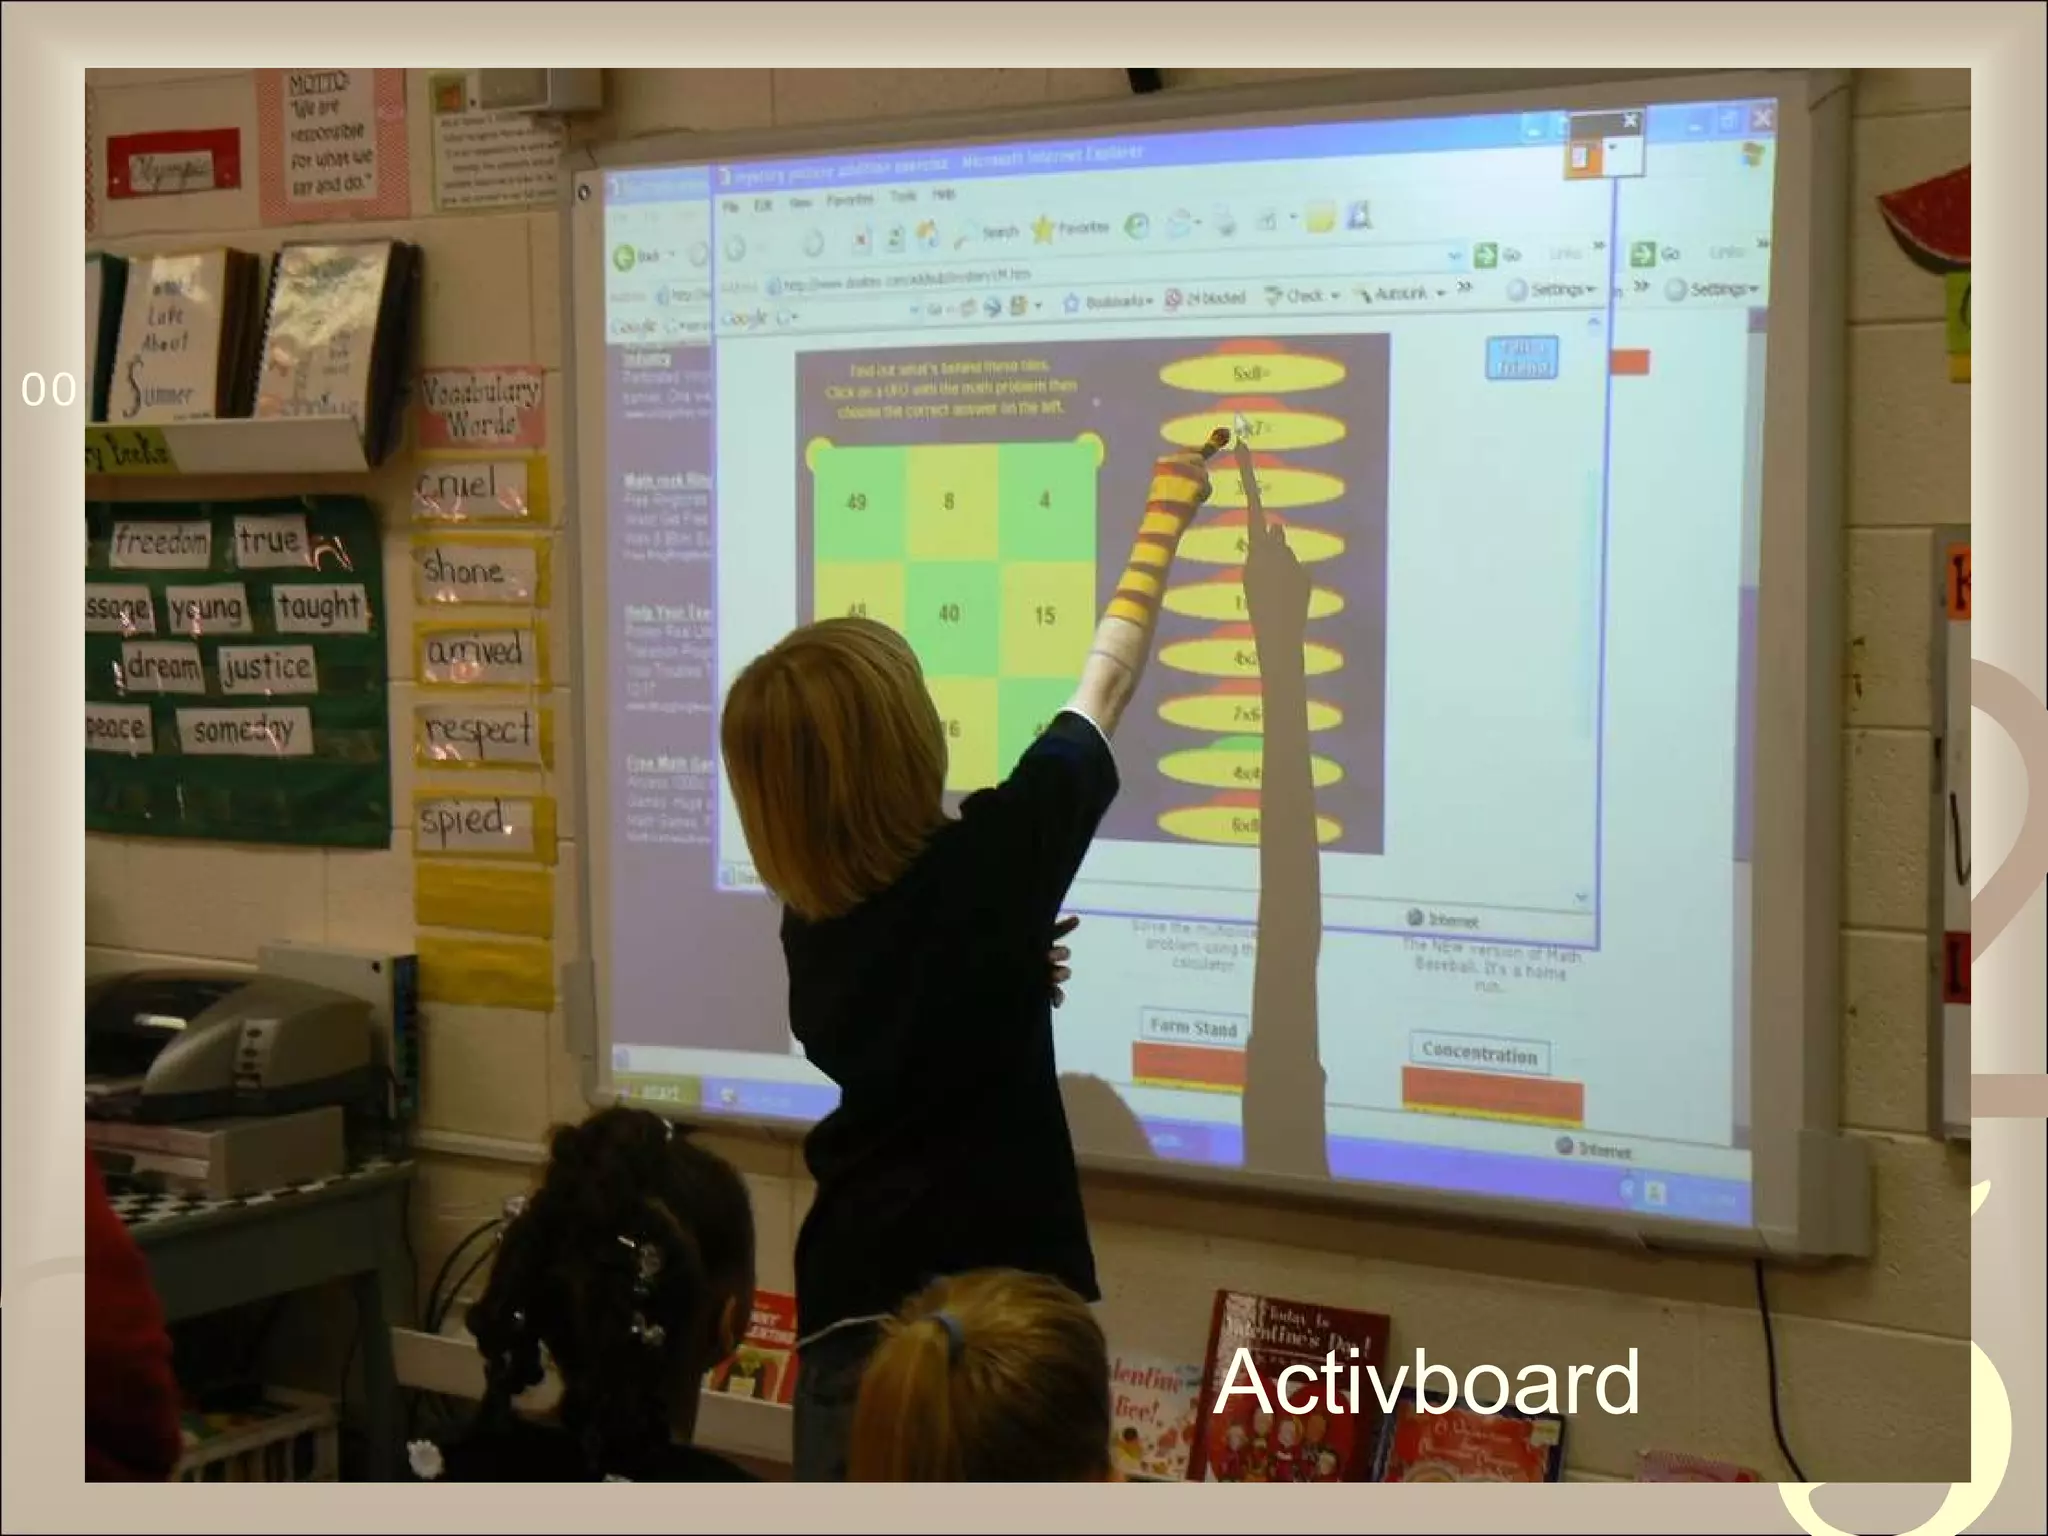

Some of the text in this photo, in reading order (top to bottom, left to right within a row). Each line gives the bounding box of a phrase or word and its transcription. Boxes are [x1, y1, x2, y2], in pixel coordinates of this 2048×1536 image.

[290, 123, 364, 141] responsible
[316, 150, 350, 168] what
[352, 147, 373, 165] we
[316, 177, 341, 195] and
[422, 376, 540, 408] Vocabulary
[441, 405, 517, 437] Words
[416, 464, 495, 498] cruel
[845, 492, 868, 511] 49
[944, 491, 955, 511] 8
[1038, 489, 1051, 510] 4
[115, 523, 207, 555] freedom
[239, 526, 301, 552] true
[423, 557, 505, 585] shone
[172, 598, 243, 629] young
[280, 593, 362, 627] taught
[938, 603, 961, 623] 40
[1035, 605, 1057, 625] 15
[427, 629, 523, 666] arrived
[1233, 650, 1258, 667] 4x2
[128, 652, 200, 682] dream
[223, 651, 311, 692] justice
[1233, 705, 1262, 722] 7x6
[194, 713, 294, 746] someday
[425, 714, 533, 759] respect
[1233, 766, 1261, 782] 4x4
[420, 796, 504, 849] spied
[1231, 815, 1260, 834] 6x8
[1429, 909, 1480, 930] Internet
[1150, 1018, 1238, 1039] Farm Stand
[1421, 1039, 1539, 1067] Concentration
[1578, 1140, 1632, 1160] Internet
